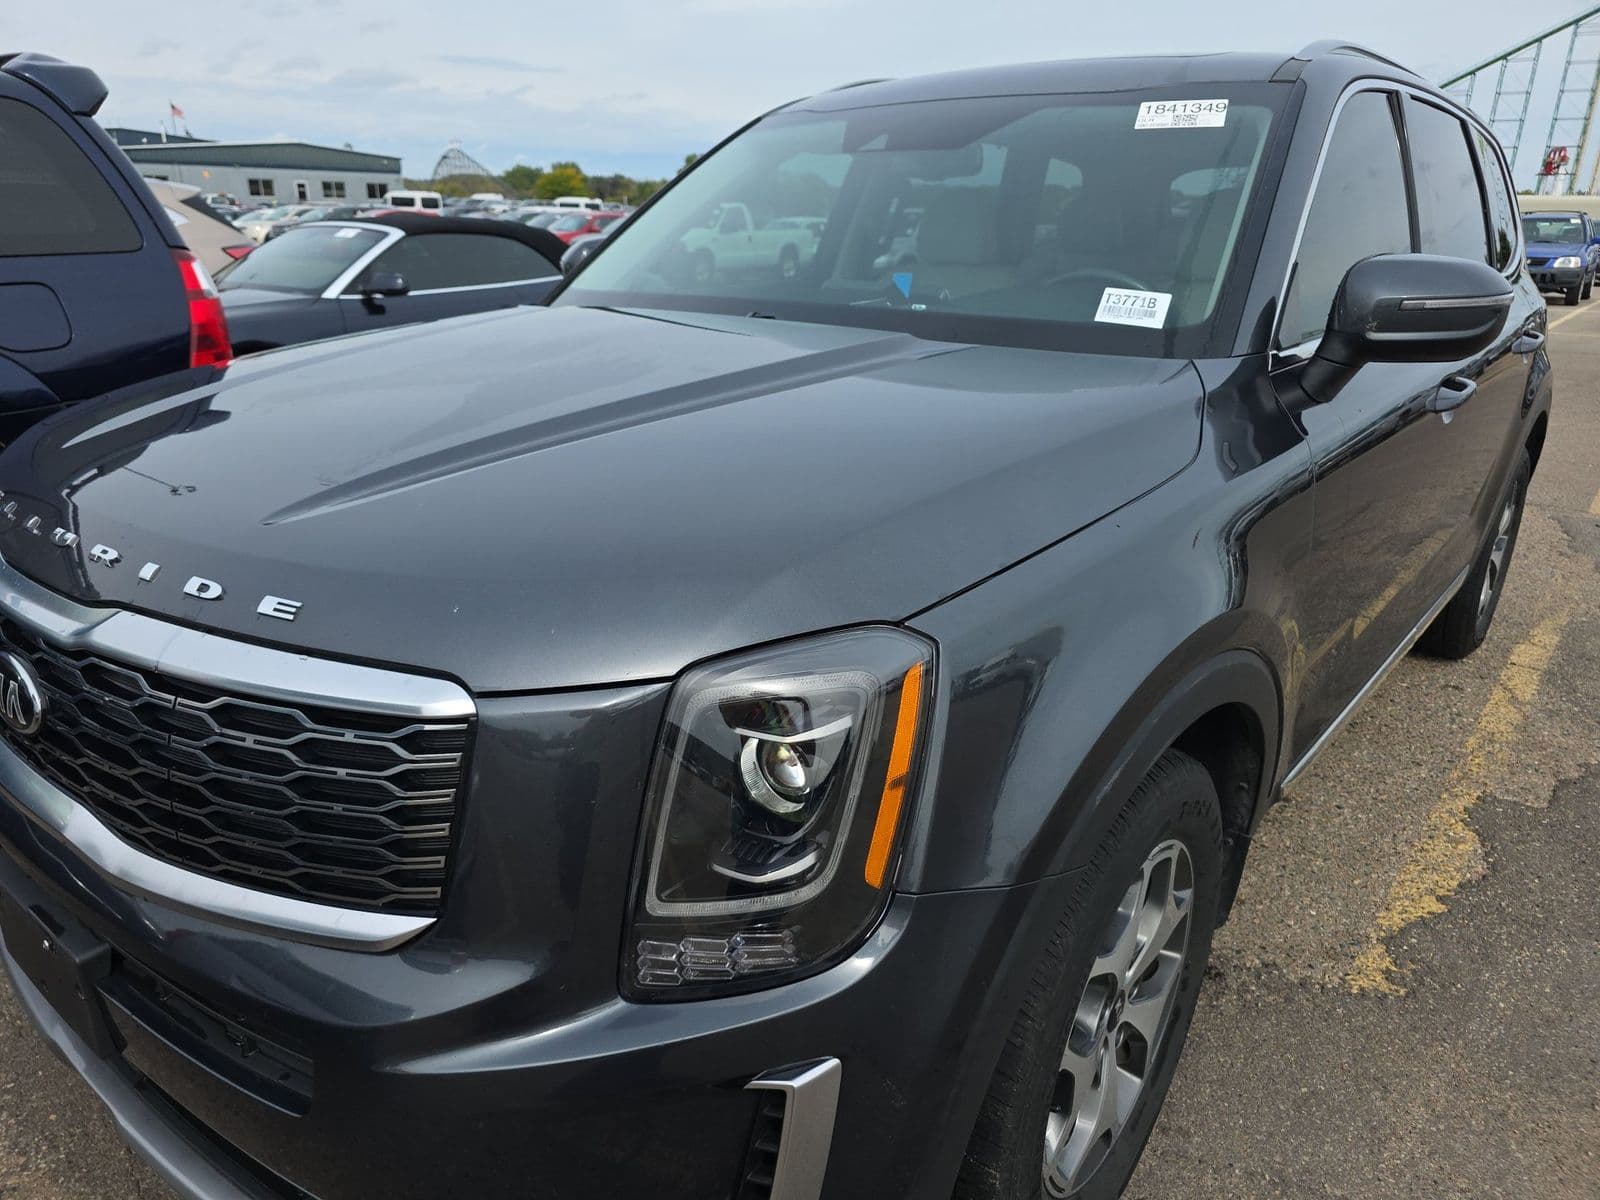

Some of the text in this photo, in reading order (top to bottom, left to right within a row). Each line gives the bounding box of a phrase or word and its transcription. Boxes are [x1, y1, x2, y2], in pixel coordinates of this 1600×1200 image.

[1145, 102, 1227, 114] 1841349
[1105, 293, 1157, 309] T3771B
[0, 490, 304, 621] LLURIDE
